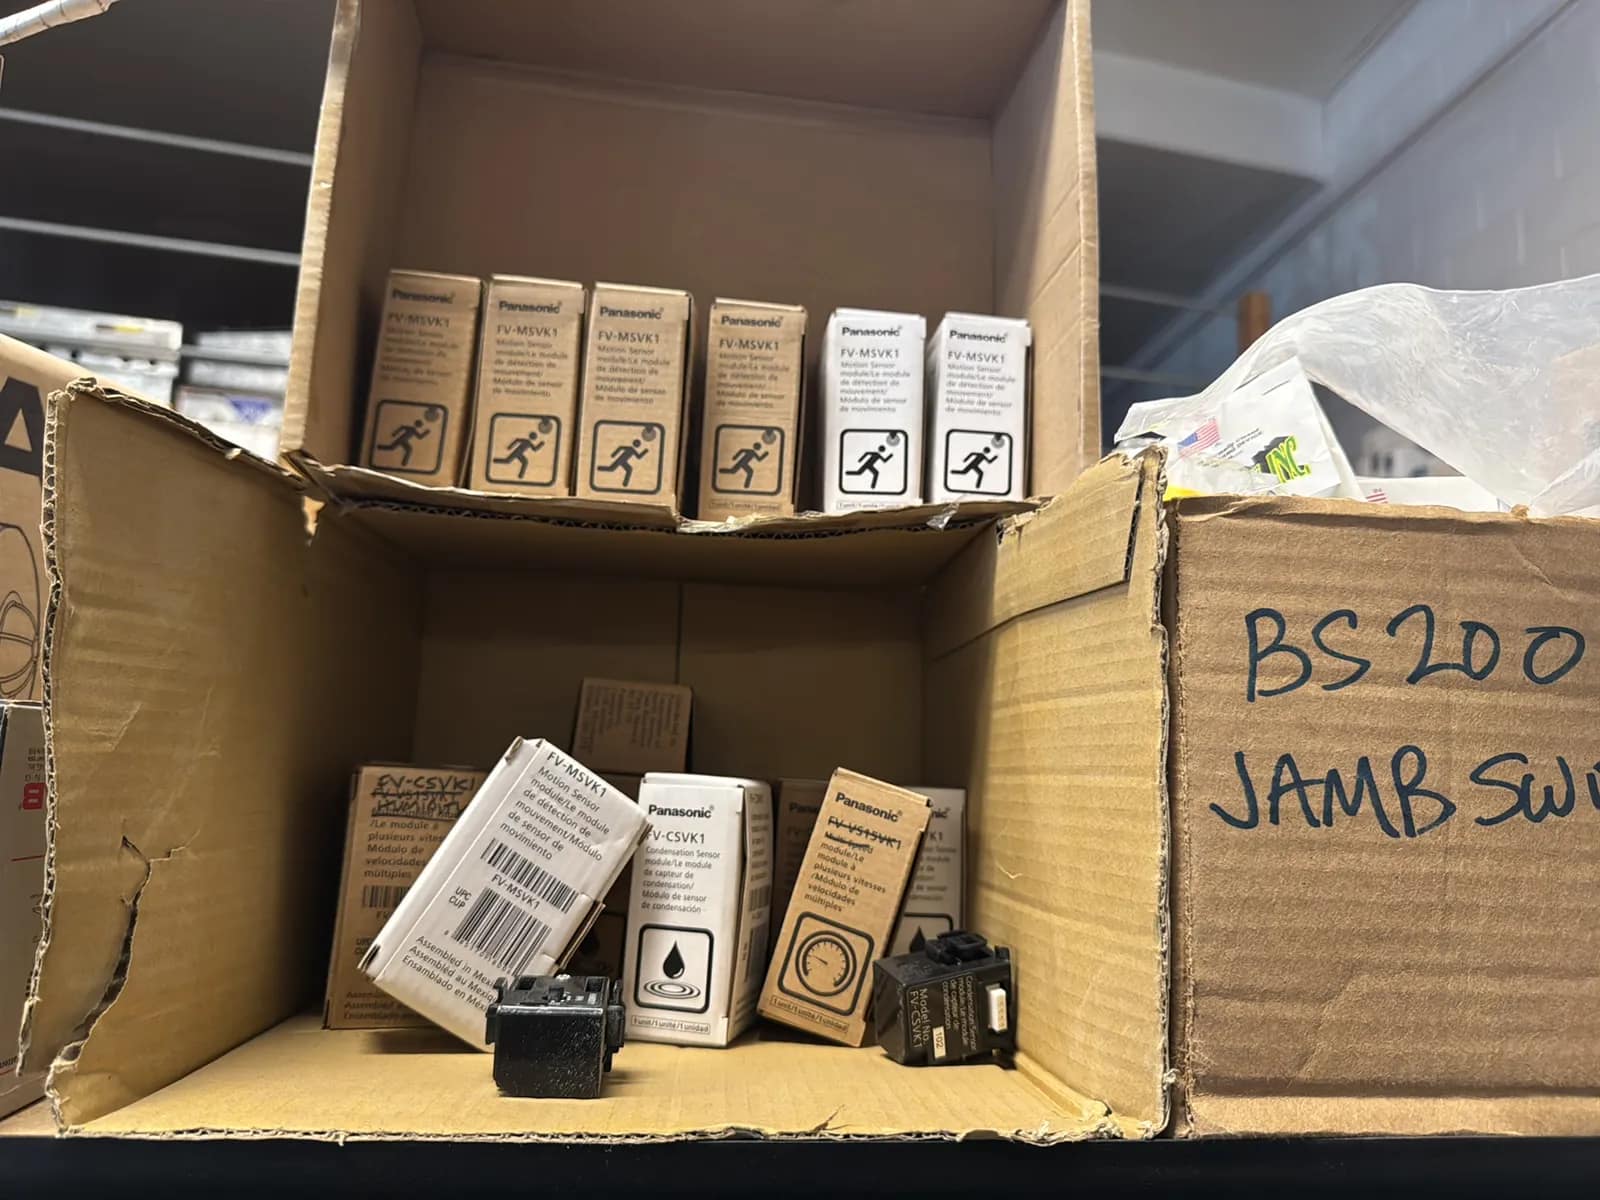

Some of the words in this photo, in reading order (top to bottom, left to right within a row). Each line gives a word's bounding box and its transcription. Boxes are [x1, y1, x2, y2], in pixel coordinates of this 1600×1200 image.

[499, 300, 561, 314] Panasonic
[600, 306, 661, 319] Panasonic
[721, 315, 781, 328] Panasonic
[496, 324, 558, 337] FV-MSVK1
[842, 326, 900, 336] Panasonic
[949, 330, 1006, 343] Panasonic
[598, 331, 660, 344] FV-MSVK1
[719, 338, 778, 351] FV-MSVK1
[840, 347, 899, 358] FV-MSVK1
[947, 351, 1005, 363] FV-MSVK1
[546, 751, 607, 798] FV-MSVK1
[538, 766, 570, 793] Motion
[571, 788, 600, 812] Sensor
[1209, 745, 1457, 838] JAMB
[523, 788, 536, 801] de
[537, 798, 578, 829] détection
[579, 825, 591, 838] de
[530, 778, 577, 812] module/Le
[577, 810, 610, 835] module
[648, 804, 712, 819] Panasonic
[835, 791, 899, 822] Panasonic
[390, 821, 430, 830] module
[508, 810, 521, 823] de
[521, 820, 551, 841] sensor
[552, 839, 565, 852] de
[368, 831, 415, 842] plusieurs
[500, 822, 553, 860] movimiento
[411, 845, 425, 854] de
[646, 846, 695, 857] Condensation
[696, 849, 721, 859] Sensor
[684, 859, 712, 869] module
[817, 852, 848, 868] module
[643, 868, 653, 876] de
[654, 869, 682, 879] capteur
[684, 870, 694, 879] de
[814, 862, 850, 881] plusieurs
[854, 876, 886, 893] vitesses
[455, 886, 472, 901] UPC
[491, 874, 541, 910] FV-MSVK1
[671, 891, 682, 900] de
[683, 894, 707, 902] sensor
[808, 883, 855, 906] velocidades
[849, 885, 859, 895] de
[448, 896, 466, 909] CUP
[641, 901, 650, 909] de
[652, 902, 701, 913] condensación
[416, 935, 463, 967] Assembled
[462, 963, 472, 974] in
[402, 954, 453, 991] Ensamblado
[454, 988, 466, 999] en
[455, 975, 467, 985] au
[919, 988, 931, 1024] Model
[910, 990, 923, 1048] FV-CSVK1
[936, 1031, 945, 1049] 102
